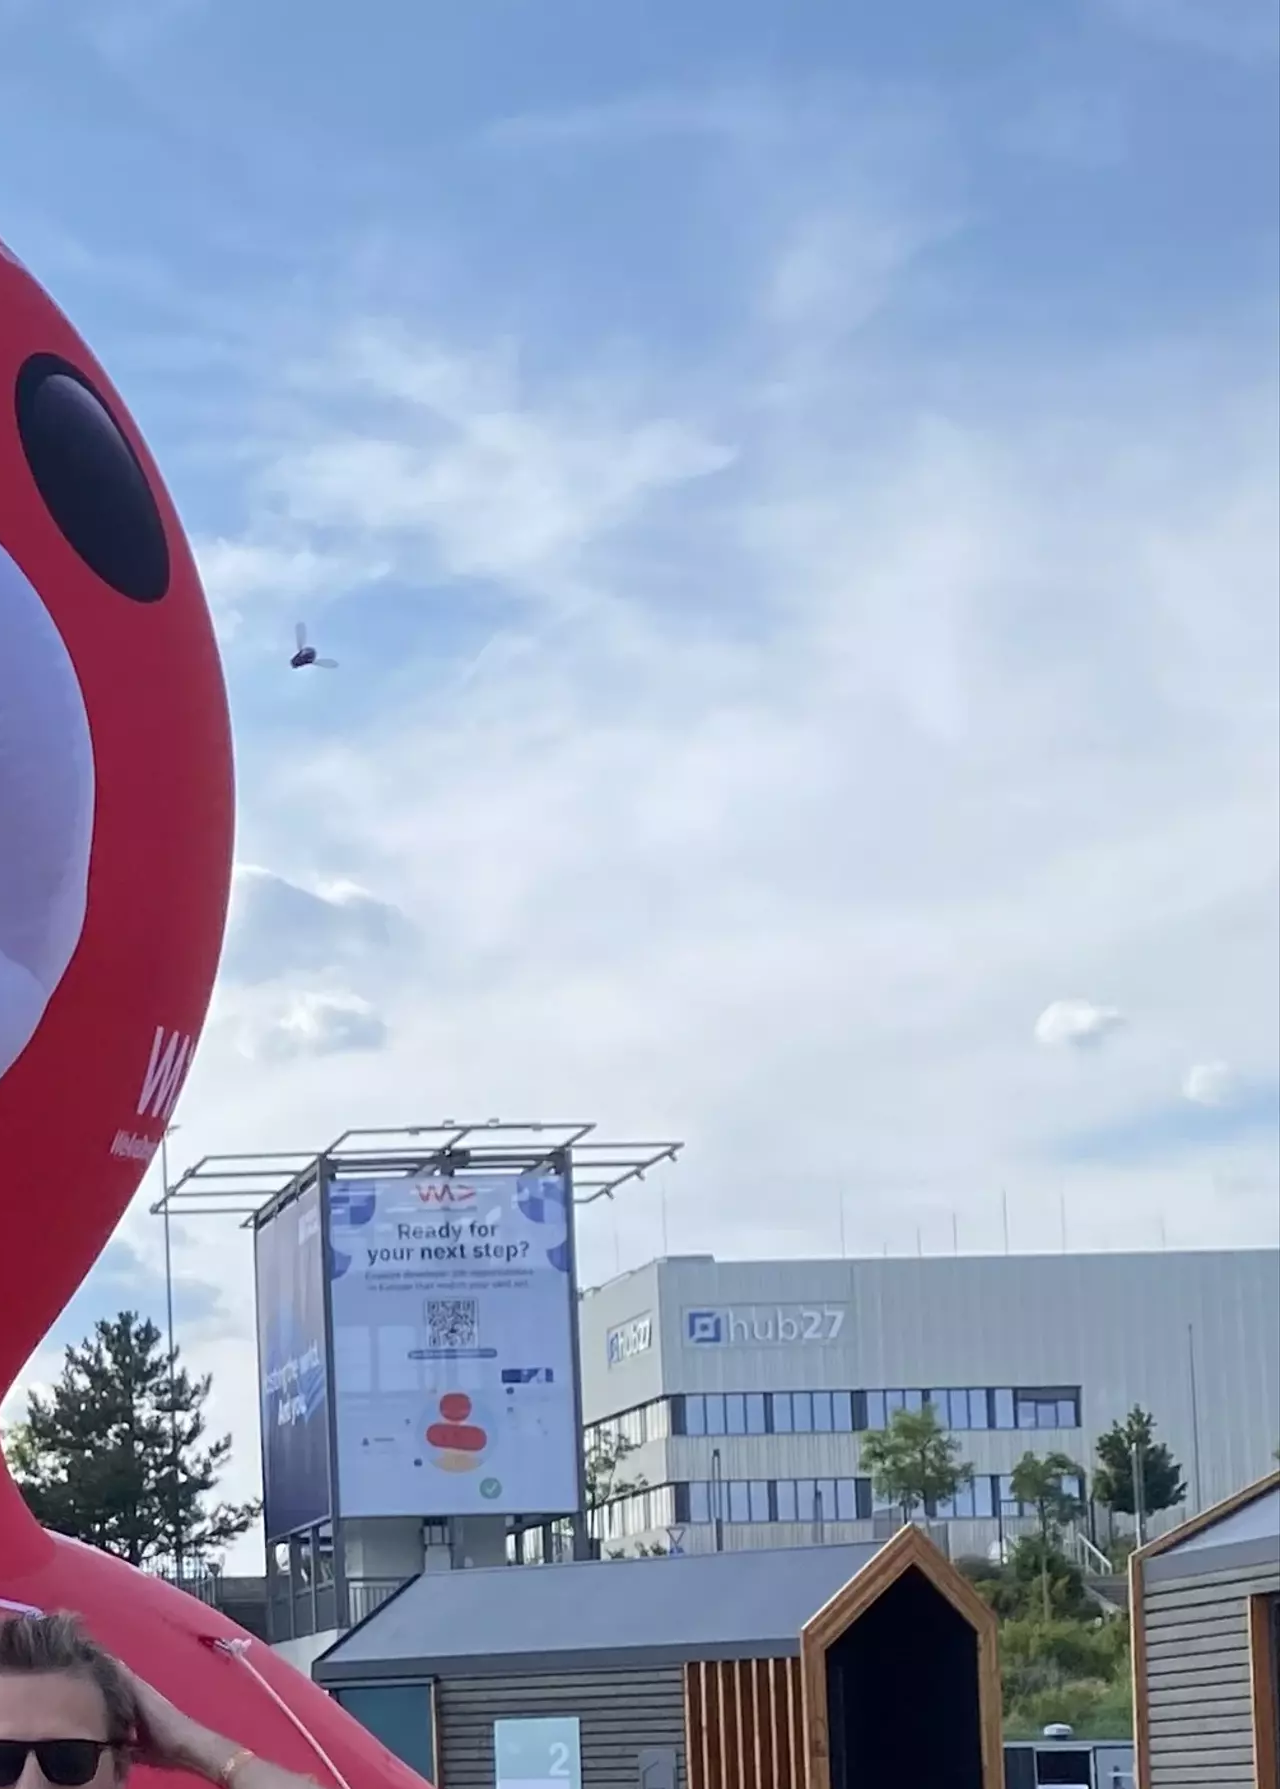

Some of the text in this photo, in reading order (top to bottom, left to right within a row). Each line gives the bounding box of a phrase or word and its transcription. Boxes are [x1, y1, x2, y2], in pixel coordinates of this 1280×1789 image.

[397, 1221, 499, 1243] Ready for
[366, 1240, 530, 1266] your next step?
[729, 1306, 845, 1342] hub27
[548, 1741, 571, 1777] 2
